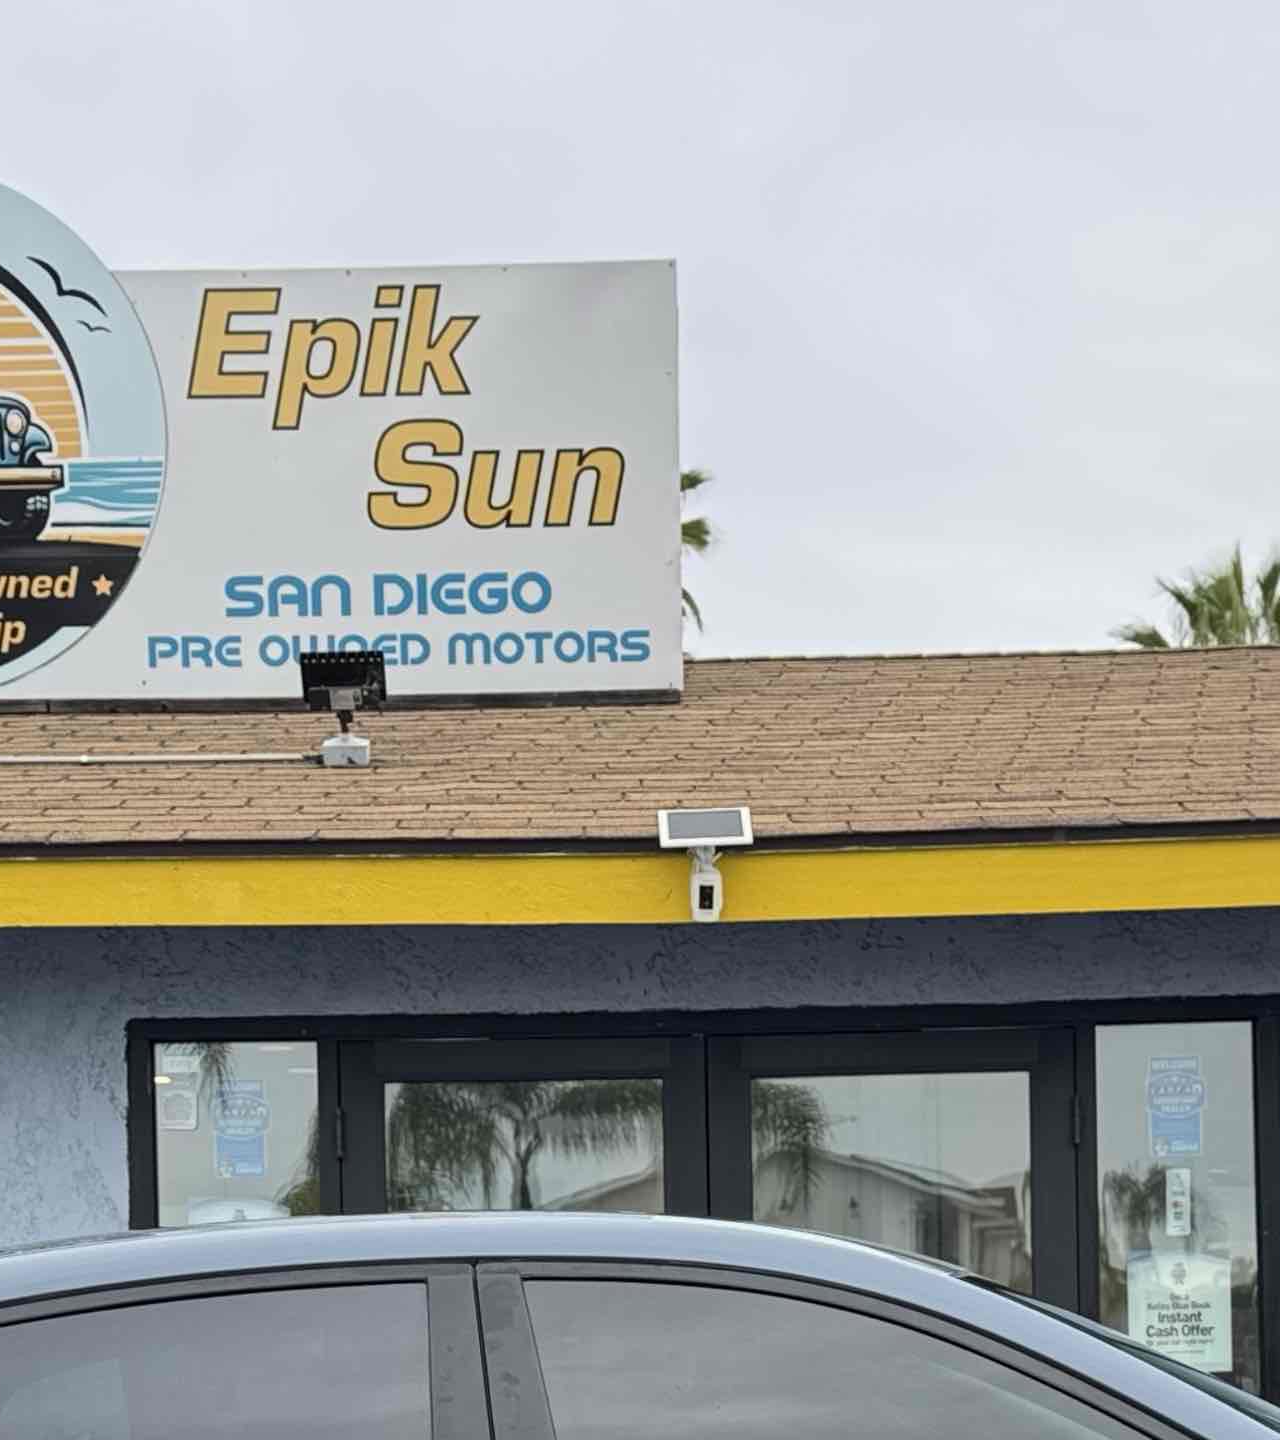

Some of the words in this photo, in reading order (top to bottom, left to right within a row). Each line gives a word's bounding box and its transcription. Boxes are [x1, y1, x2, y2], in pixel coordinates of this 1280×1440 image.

[187, 284, 481, 430] Epik
[367, 418, 625, 530] Sun
[223, 574, 352, 618] SAN
[372, 571, 552, 617] DIEGO
[147, 635, 243, 669] PRE
[447, 630, 652, 666] MOTORS
[1146, 1325, 1179, 1337] Cash
[1182, 1324, 1216, 1337] Offer
[1158, 1311, 1203, 1323] Instant
